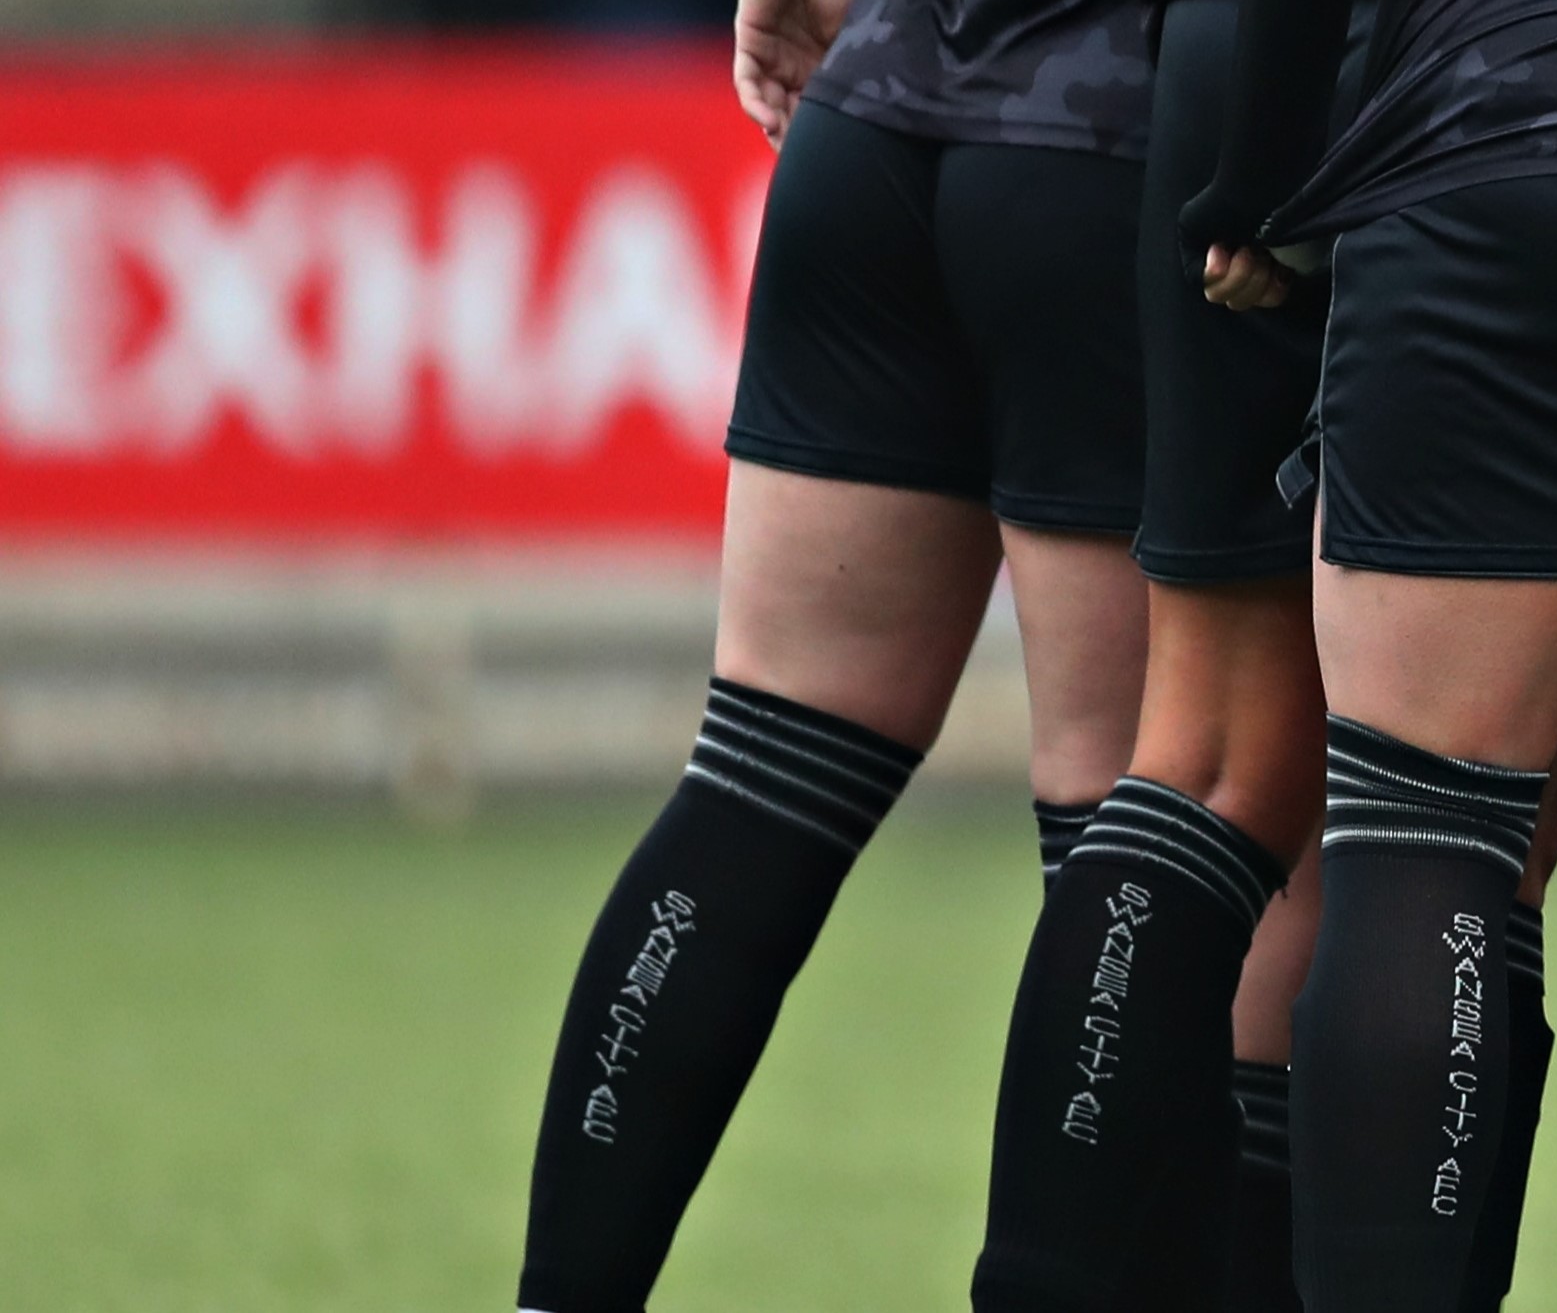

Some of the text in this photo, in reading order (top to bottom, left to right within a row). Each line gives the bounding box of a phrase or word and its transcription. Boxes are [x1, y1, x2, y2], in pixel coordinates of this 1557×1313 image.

[0, 158, 772, 461] EXHA
[582, 890, 696, 1144] SWANSEA CITY AFC
[1061, 883, 1152, 1145] SWANSEA CITY AFC
[1431, 912, 1485, 1216] SWANSEA CITY AFC
